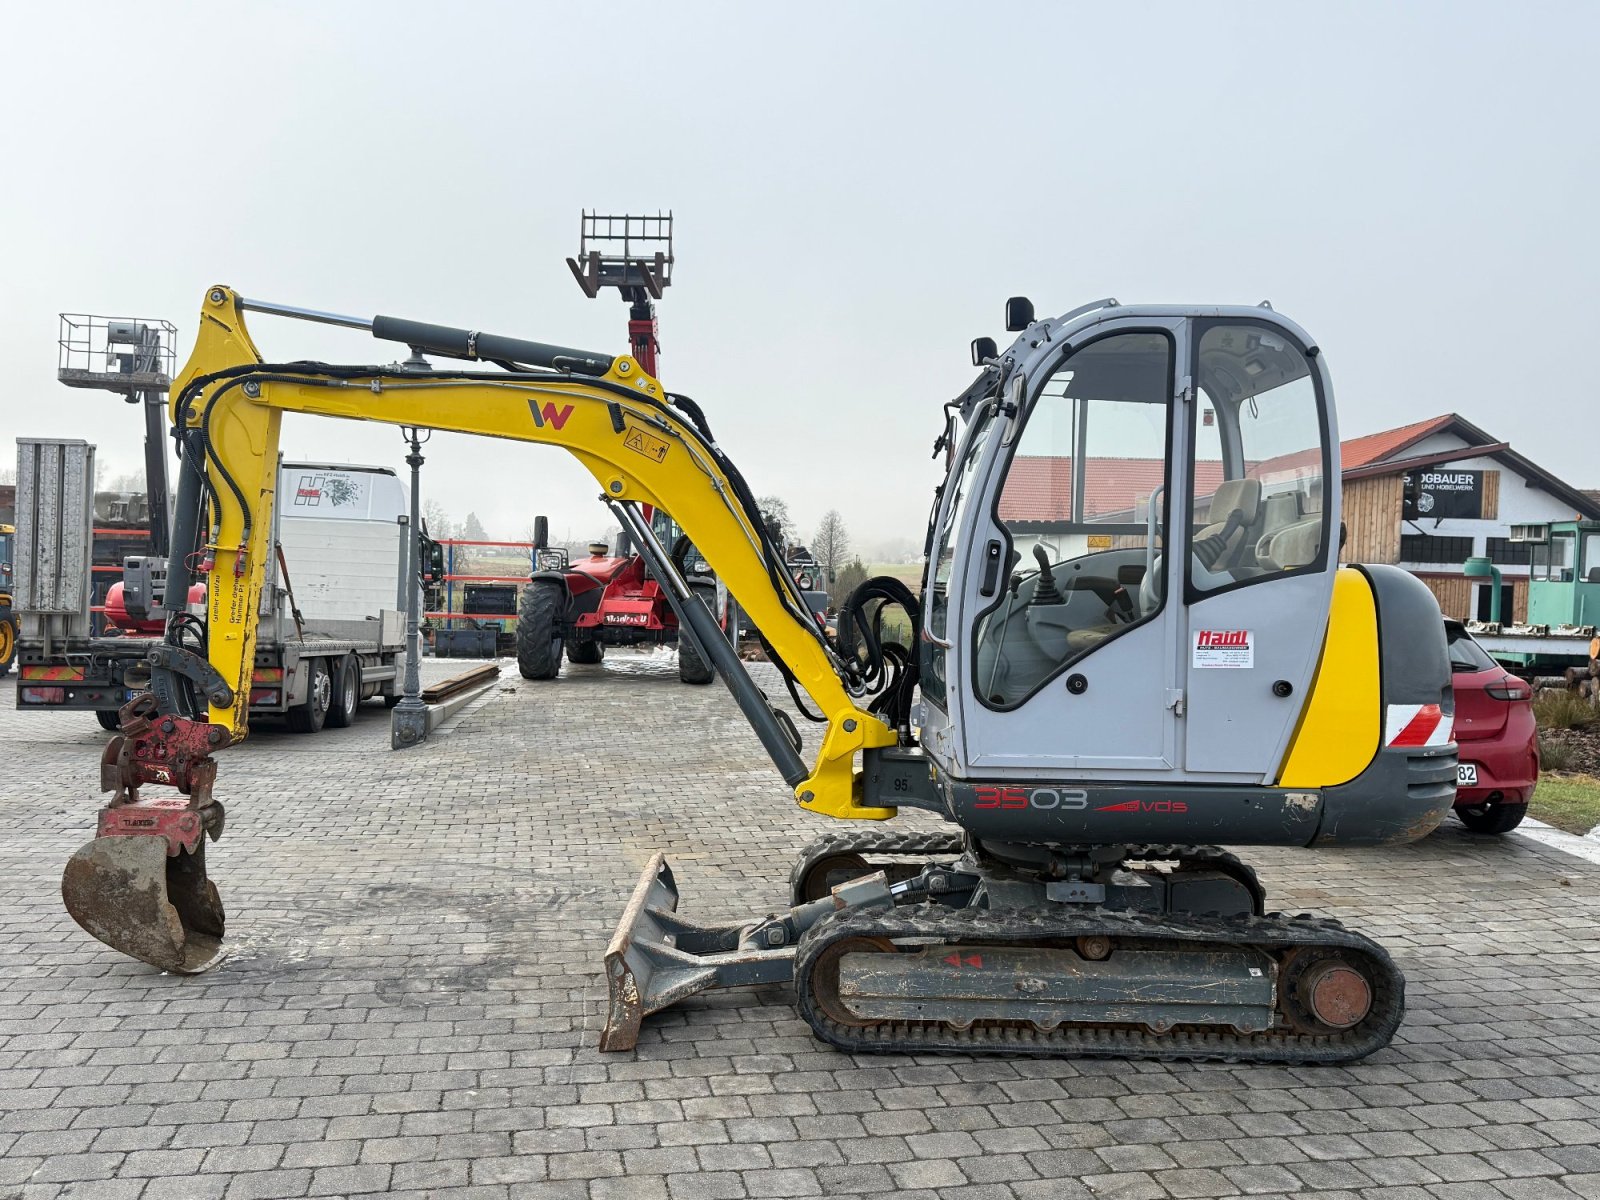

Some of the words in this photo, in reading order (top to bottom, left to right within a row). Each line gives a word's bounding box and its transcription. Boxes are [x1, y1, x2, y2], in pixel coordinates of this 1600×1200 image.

[1436, 484, 1474, 492] HOBELWERK
[1198, 630, 1249, 646] Haidl
[1458, 766, 1476, 780] 82
[894, 778, 908, 791] 95
[974, 787, 1088, 810] 3503
[1141, 800, 1188, 813] vds
